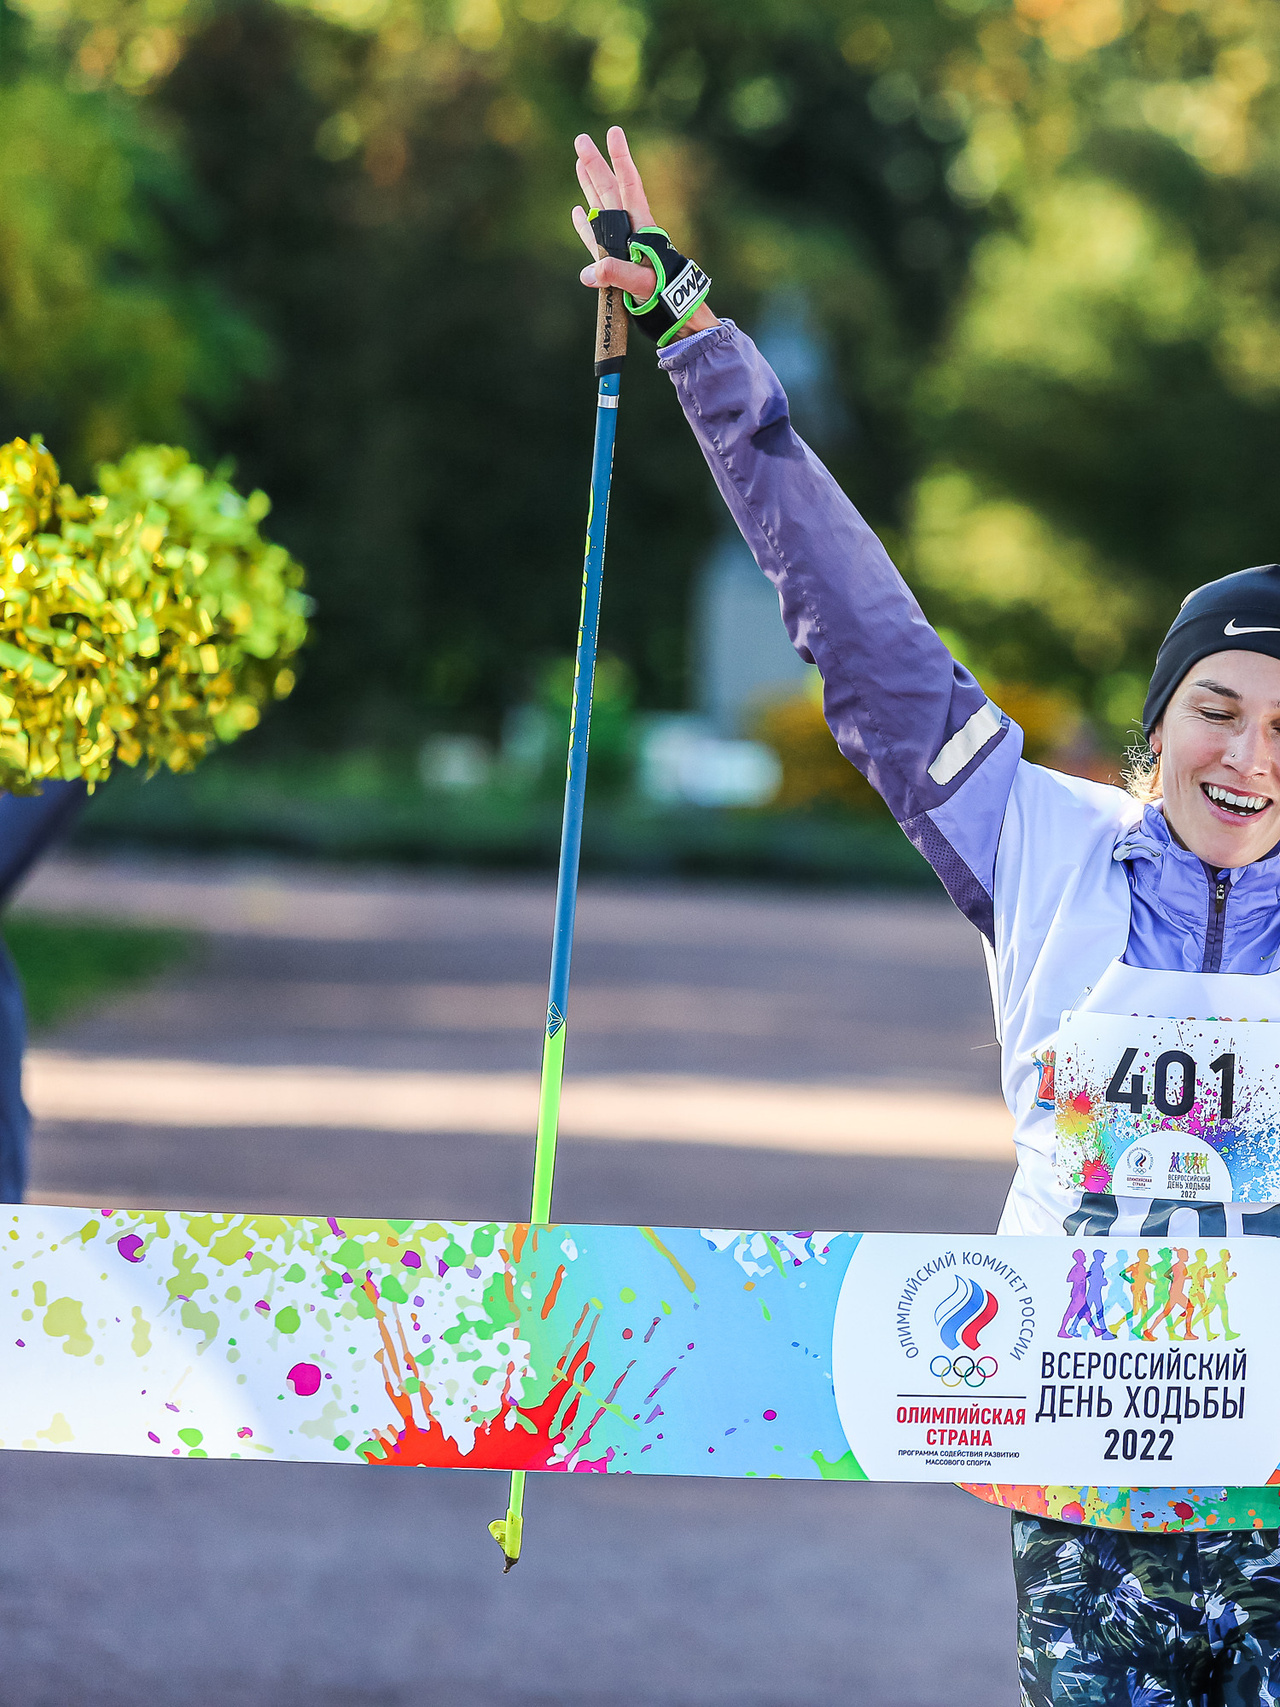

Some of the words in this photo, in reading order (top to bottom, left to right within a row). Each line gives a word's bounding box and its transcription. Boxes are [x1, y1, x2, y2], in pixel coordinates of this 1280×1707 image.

[603, 286, 613, 354] NEWAY
[1105, 1047, 1236, 1120] 401
[1167, 1181, 1183, 1189] ДЕНЬ
[1185, 1181, 1211, 1190] ХОДЬБЫ
[1168, 1174, 1211, 1183] ВСЕРОССИЙСКИЙ
[1180, 1190, 1197, 1198] 2022
[896, 1250, 957, 1359] ОЛИМПИЙСКИЙ
[962, 1251, 1028, 1293] КОМИТЕТ
[1009, 1296, 1036, 1361] РОССИИ
[1041, 1348, 1247, 1381] ВСЕРОССИЙСКИЙ
[896, 1403, 1026, 1425] ОЛИМПИЙСКАЯ
[1036, 1385, 1112, 1423] ДЕНЬ
[1124, 1386, 1245, 1424] ХОДЬБЫ
[926, 1429, 992, 1446] СТРАНА
[1103, 1428, 1174, 1461] 2022
[940, 1450, 983, 1458] СОДЕЙСТВИЯ
